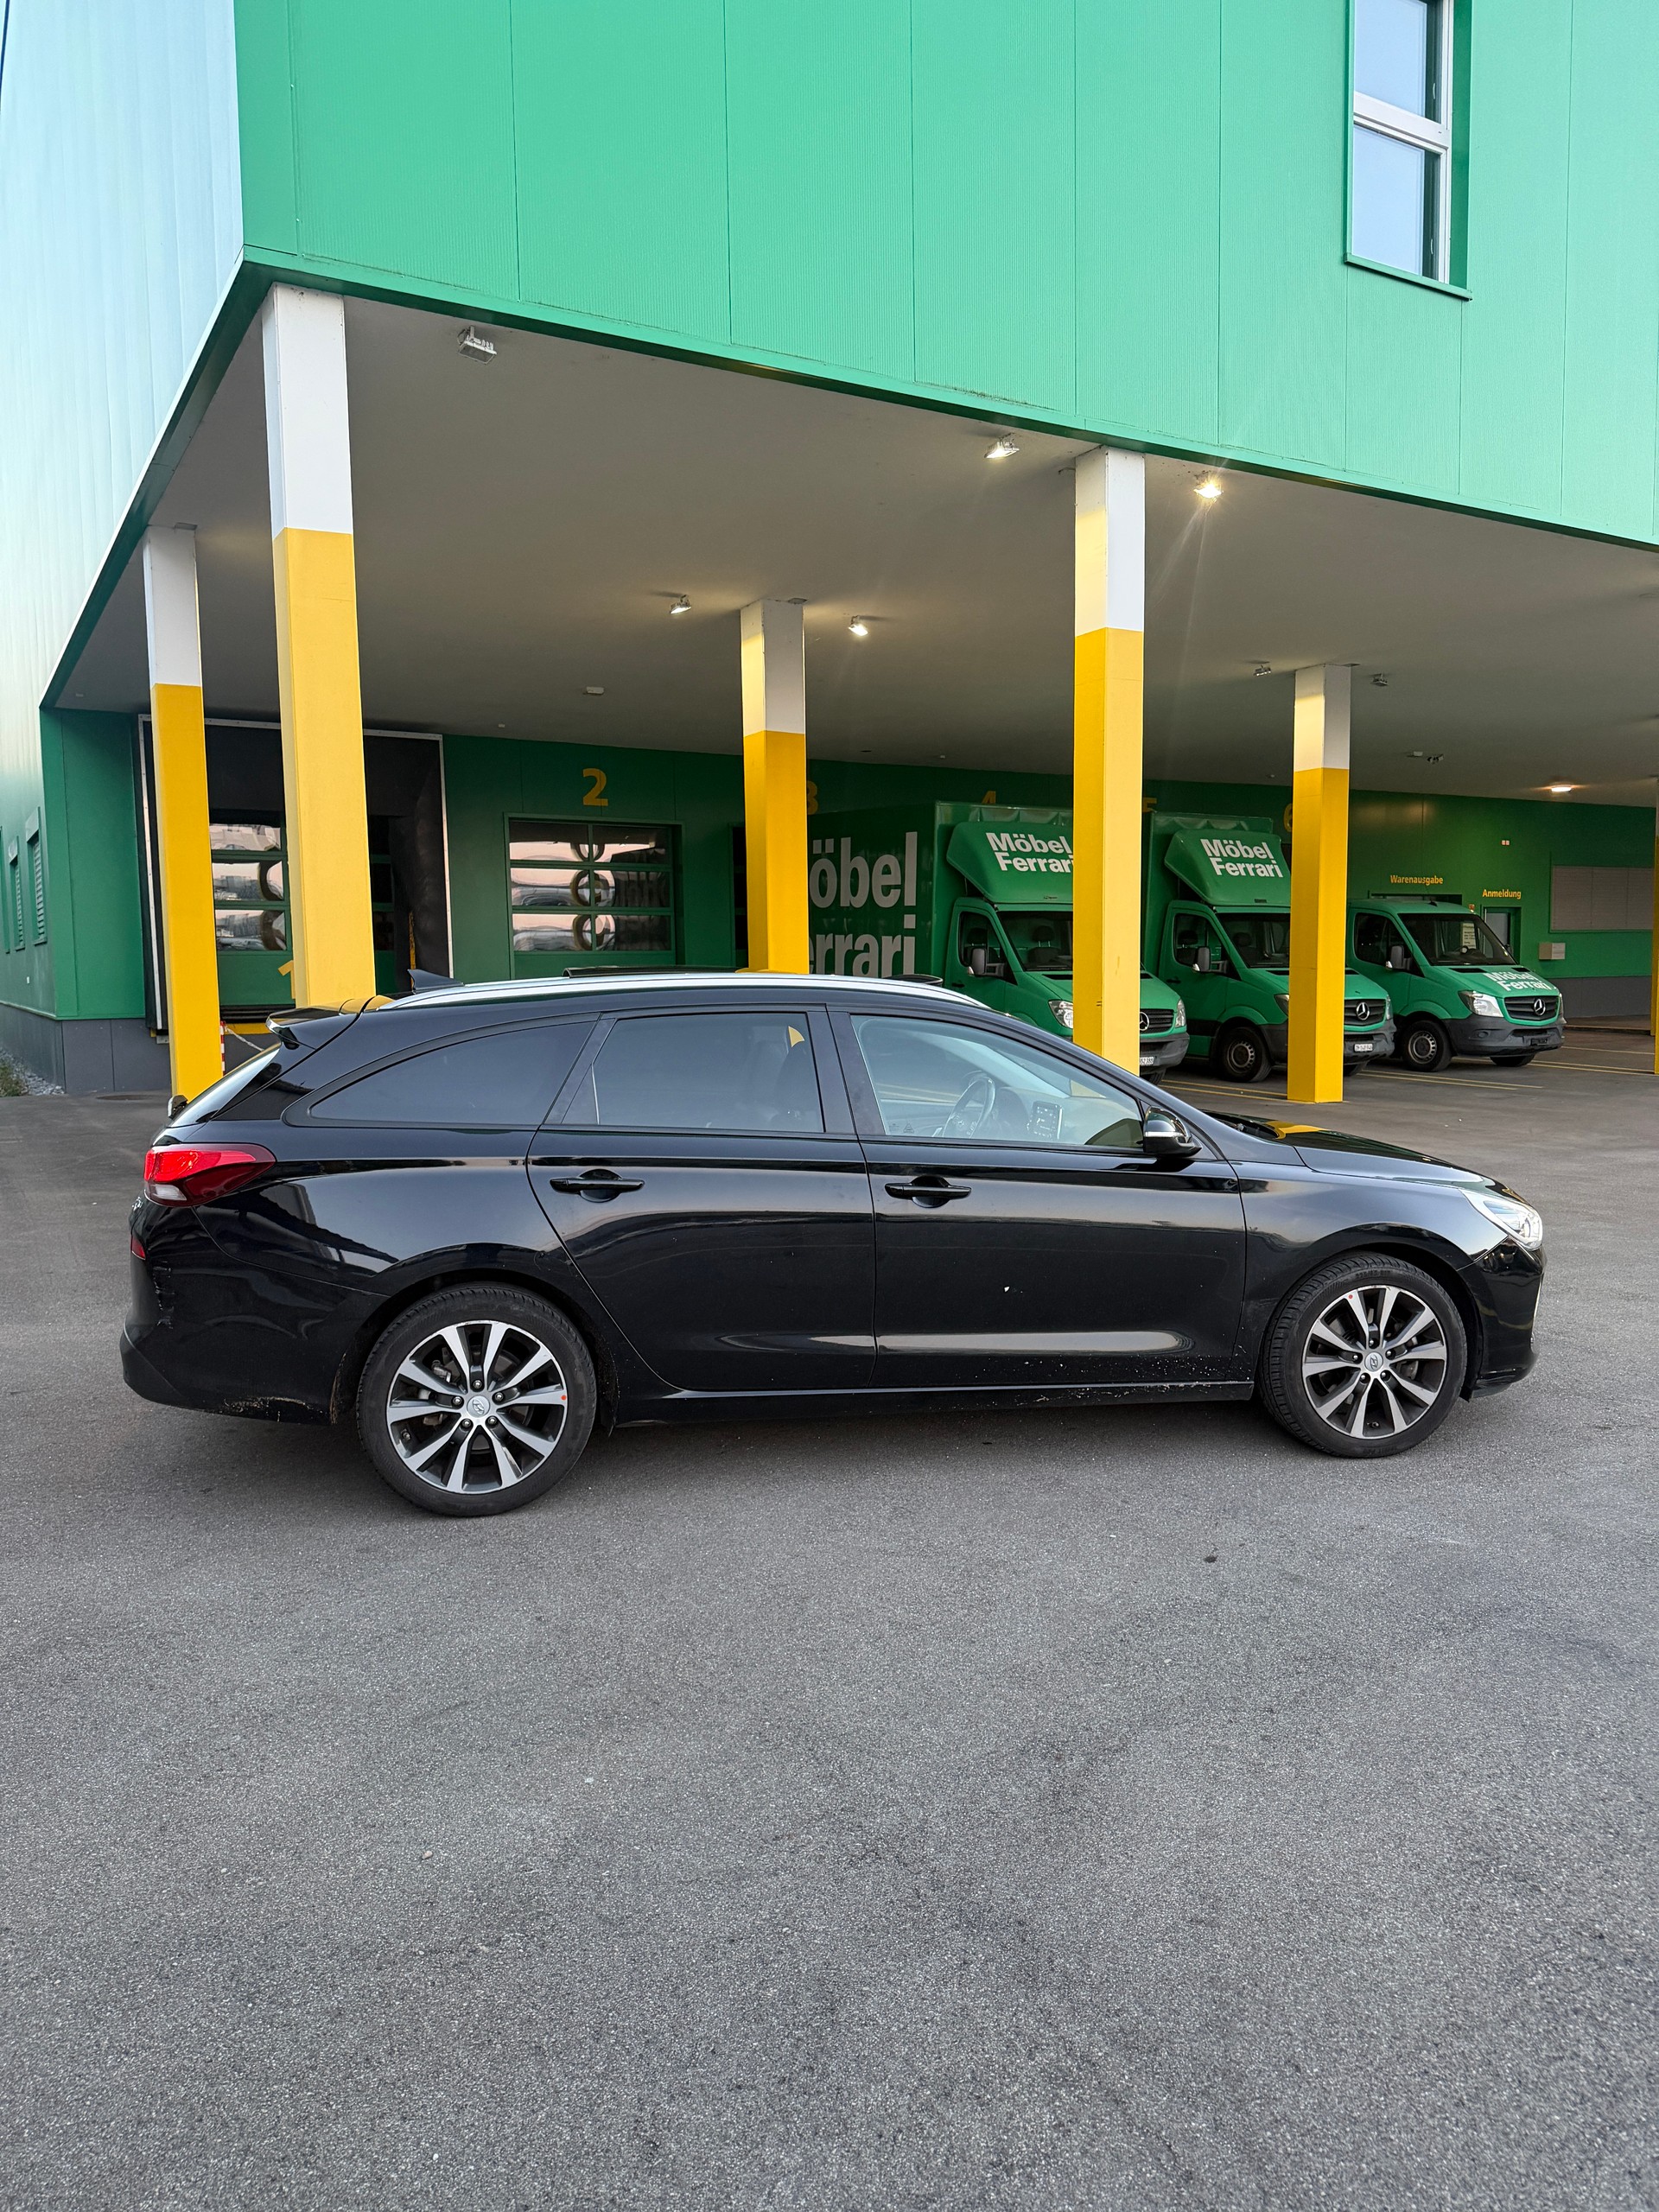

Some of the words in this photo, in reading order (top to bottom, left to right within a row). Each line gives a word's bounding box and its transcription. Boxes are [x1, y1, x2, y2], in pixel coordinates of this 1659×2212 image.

[582, 767, 608, 806] 2
[985, 832, 1072, 854] Möbel
[1200, 838, 1274, 860] Möbel
[809, 831, 918, 908] öbel
[1210, 857, 1284, 878] Ferrari
[1389, 874, 1444, 887] Warenausgabe
[1482, 888, 1522, 899] Anmeldung
[809, 914, 917, 978] rrari
[1483, 971, 1541, 982] Möbel
[1497, 980, 1553, 992] Ferrari
